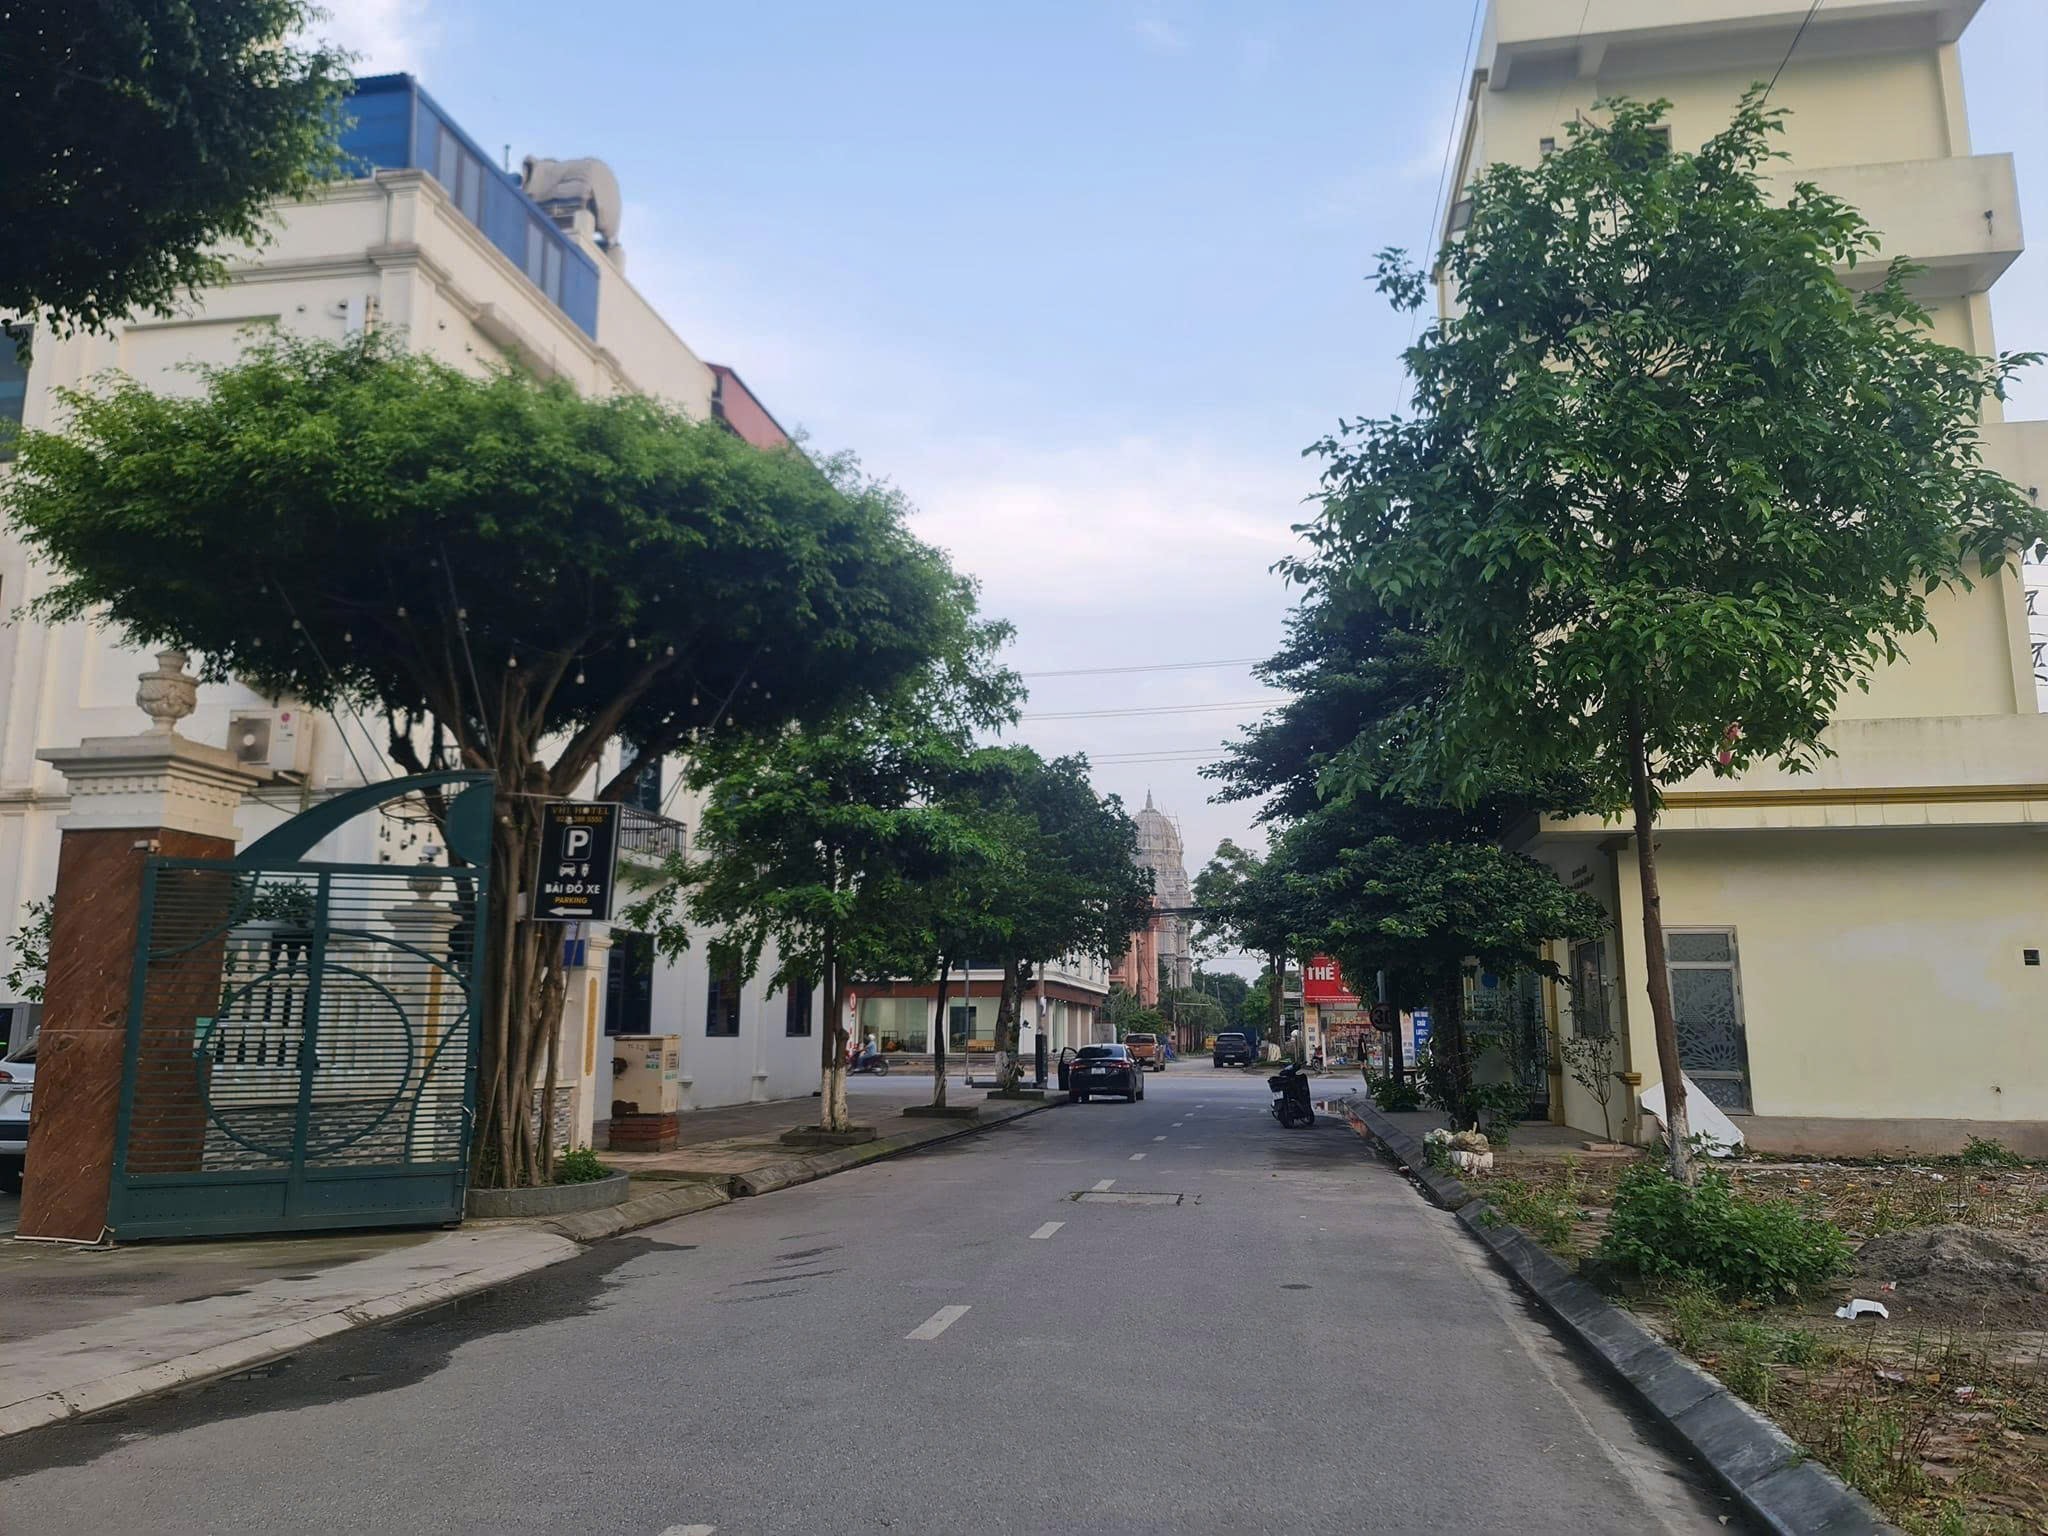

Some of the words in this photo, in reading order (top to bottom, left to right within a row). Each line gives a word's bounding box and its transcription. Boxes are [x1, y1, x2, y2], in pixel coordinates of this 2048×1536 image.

[567, 830, 589, 857] P
[586, 885, 601, 894] XE
[555, 897, 588, 905] PARKING
[1307, 961, 1335, 980] THẾ
